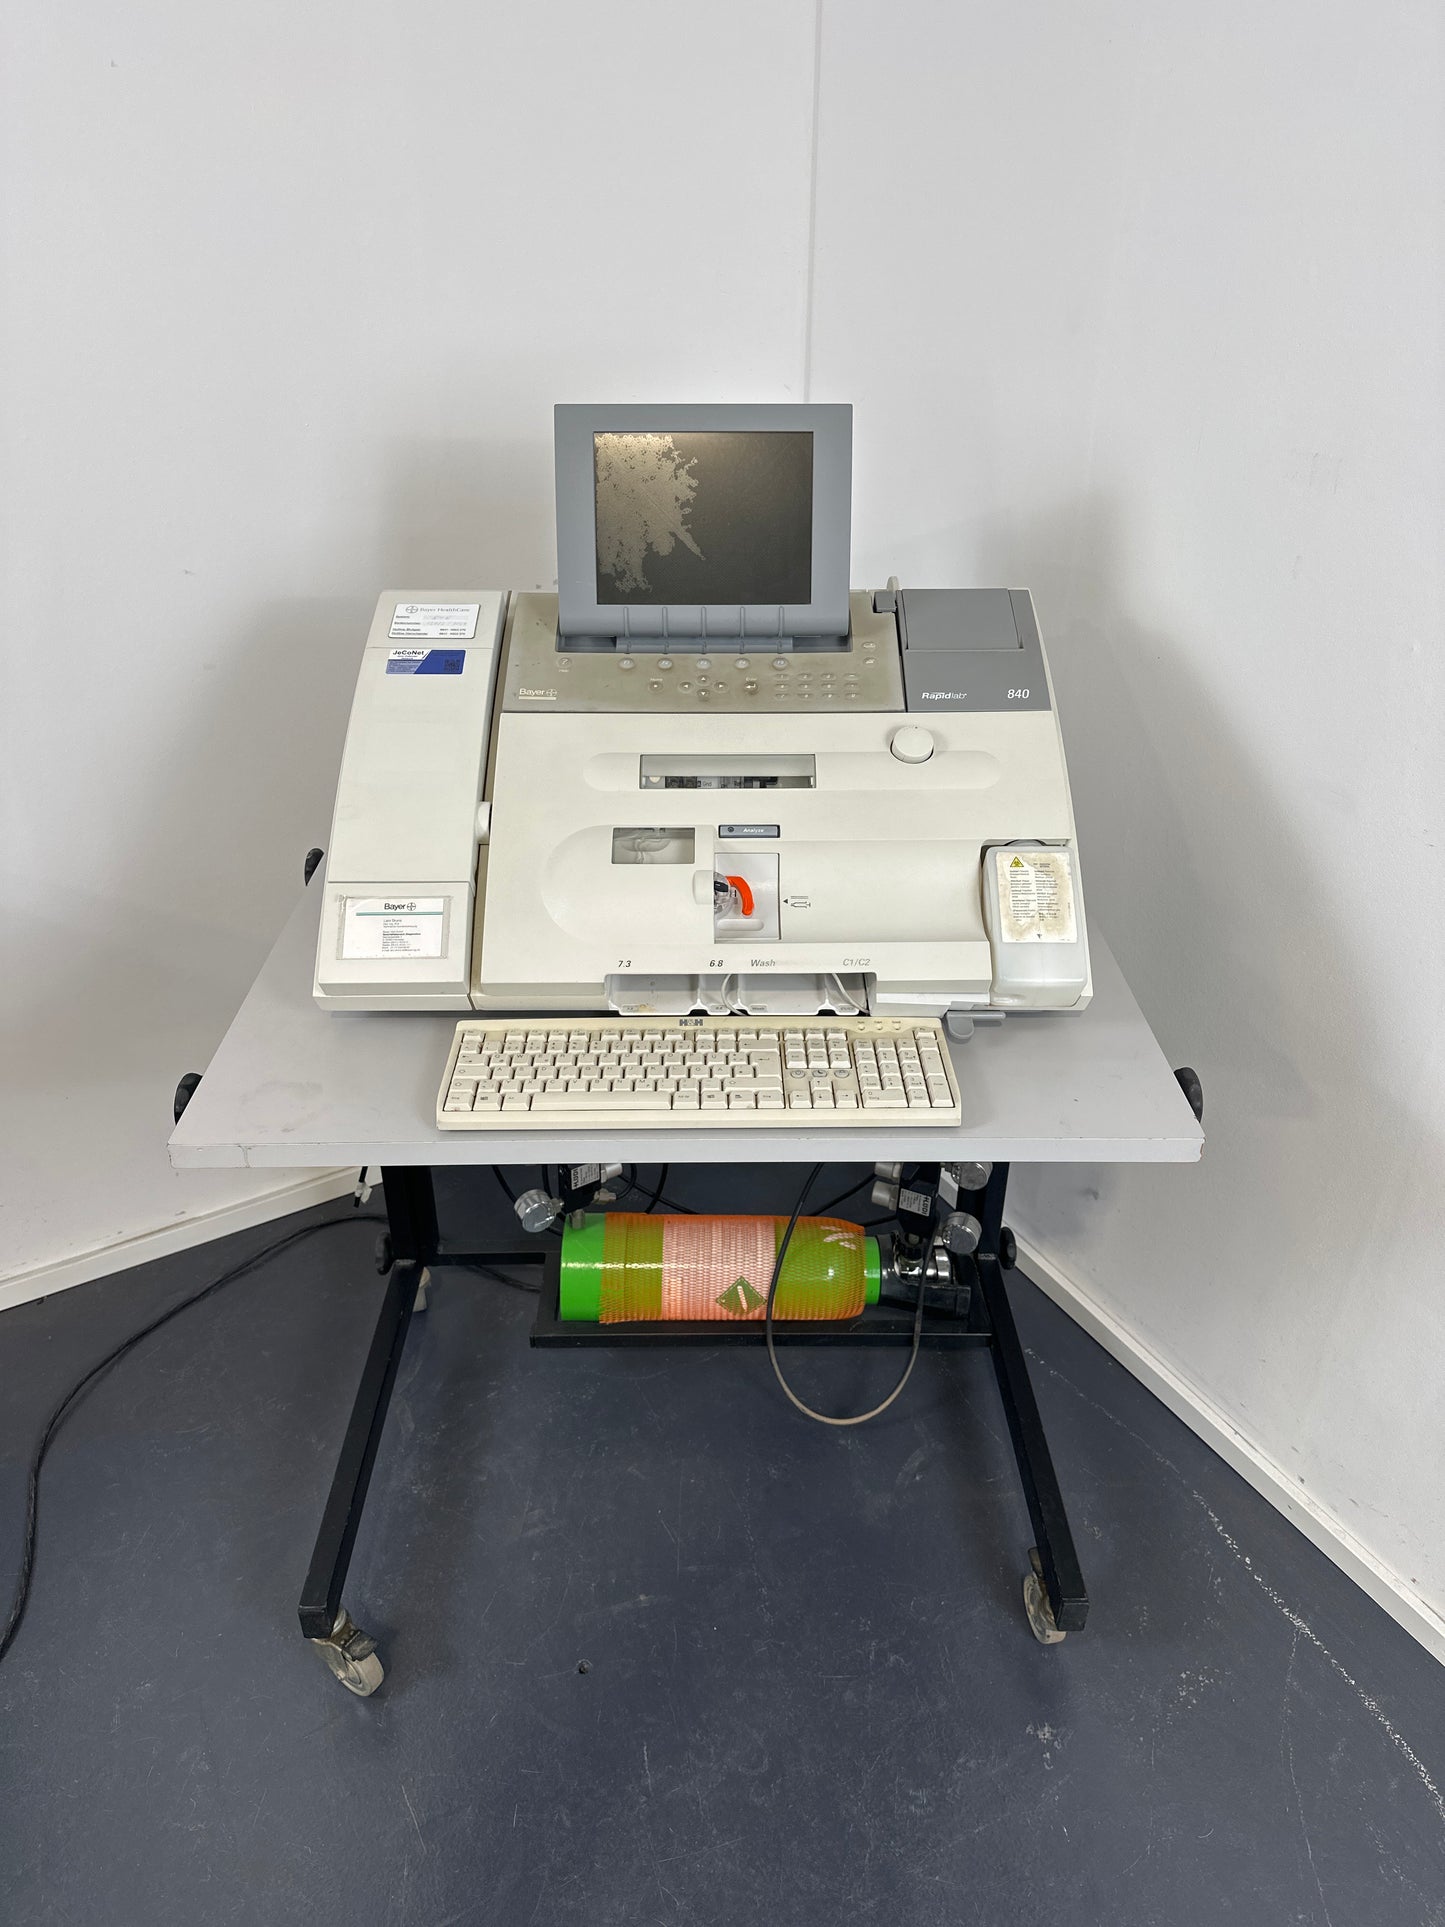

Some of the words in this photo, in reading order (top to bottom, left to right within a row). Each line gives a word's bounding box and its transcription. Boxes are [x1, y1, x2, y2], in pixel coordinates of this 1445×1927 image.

[519, 688, 545, 697] Bayer
[1007, 689, 1030, 699] 840
[384, 903, 405, 911] Bayer
[750, 959, 776, 967] Wash
[842, 958, 871, 967] C1/C2
